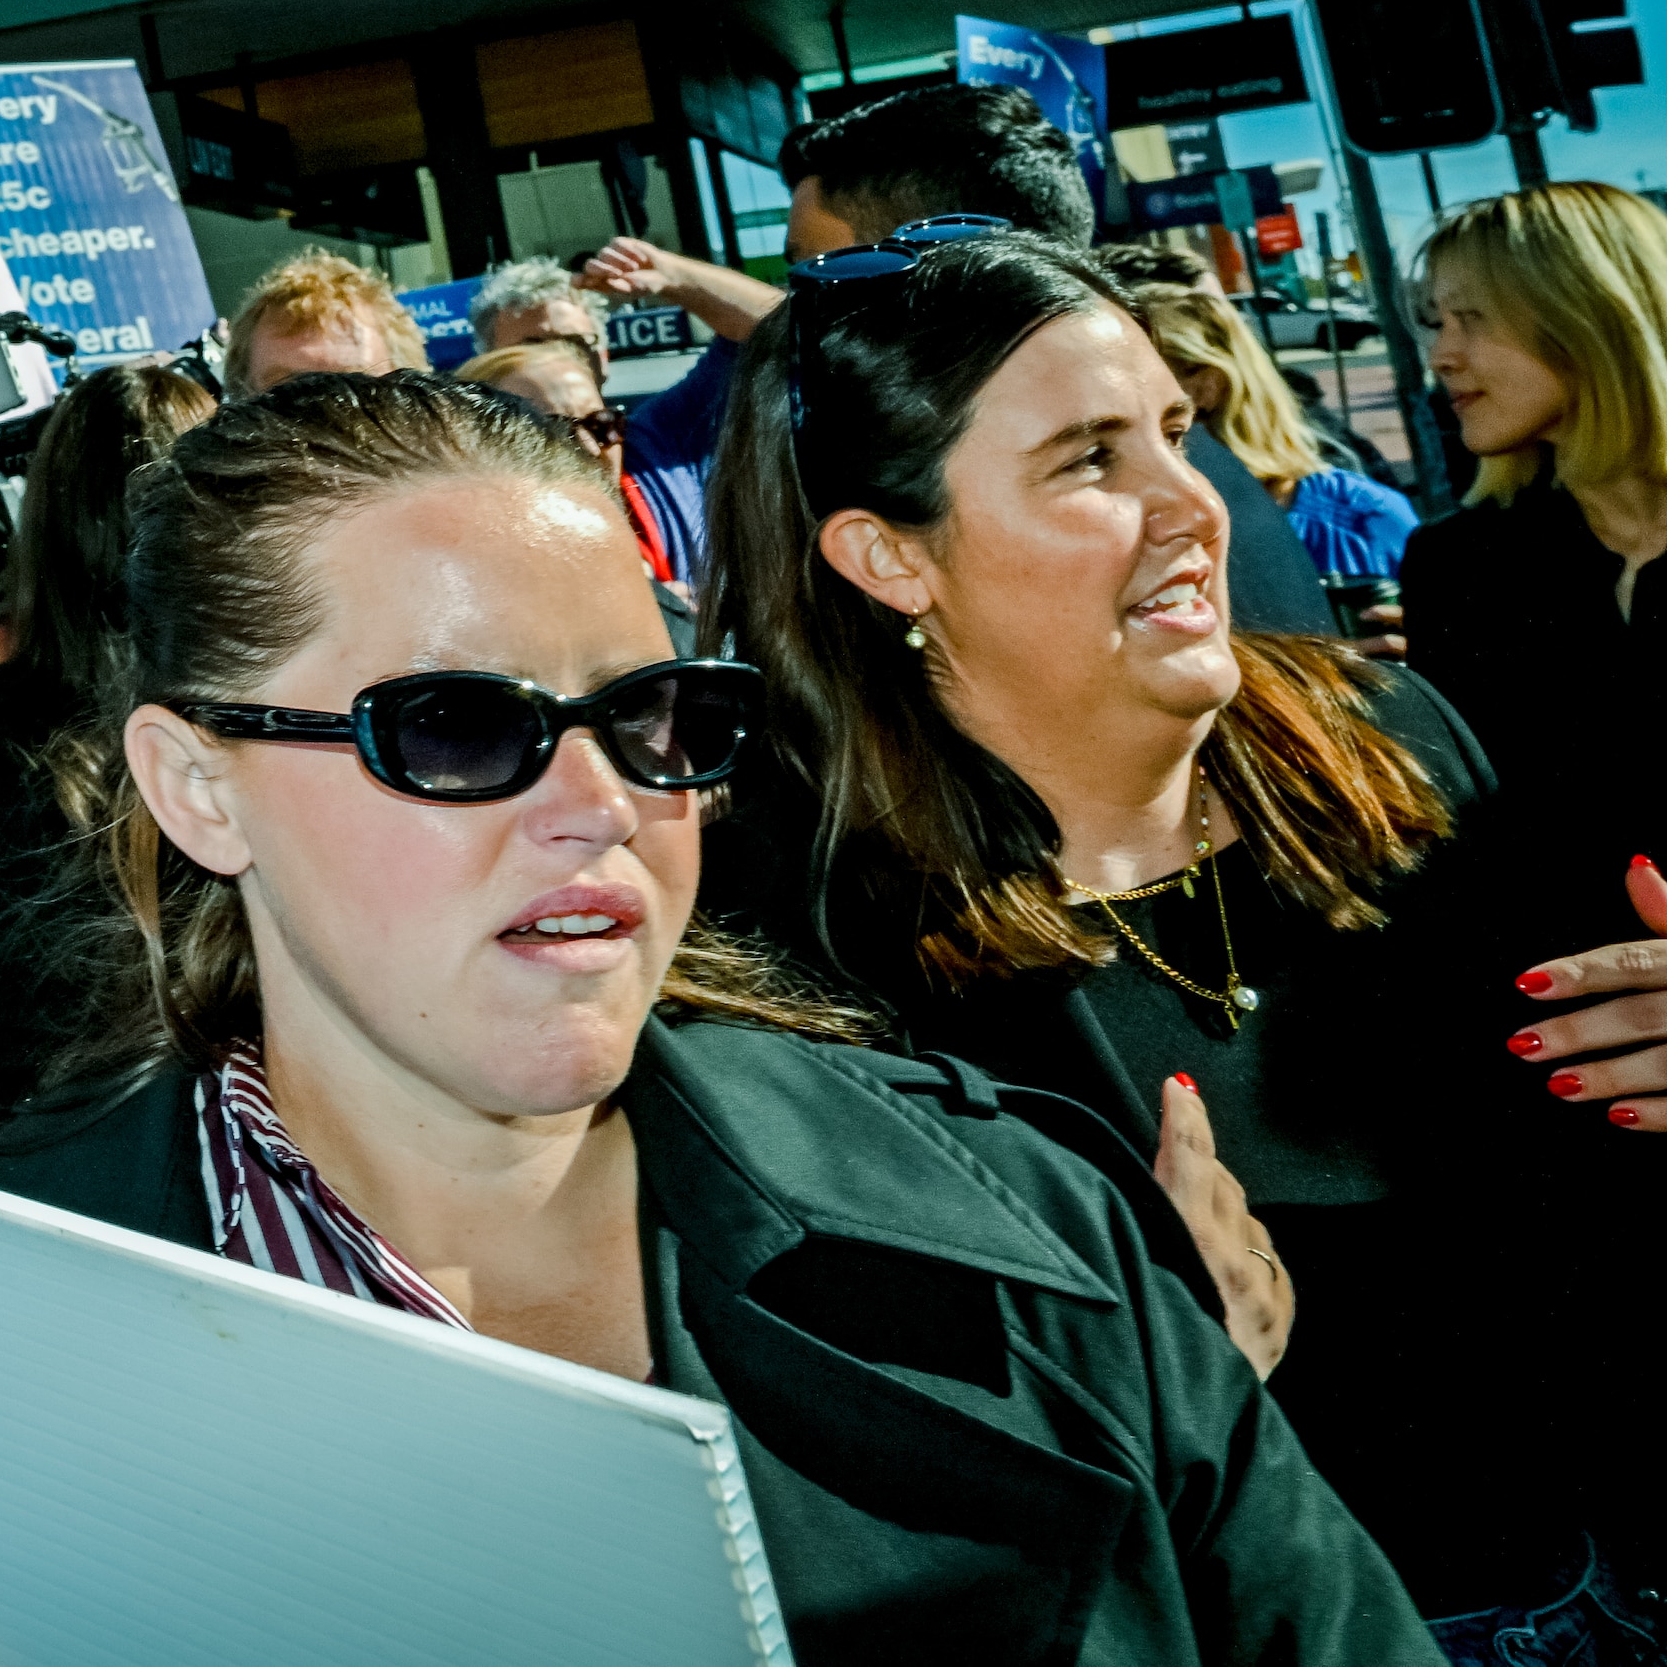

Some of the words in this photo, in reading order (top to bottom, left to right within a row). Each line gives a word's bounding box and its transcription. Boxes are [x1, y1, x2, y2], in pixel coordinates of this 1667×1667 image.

[969, 35, 1044, 79] Every
[76, 316, 154, 354] eral
[606, 315, 681, 349] ICE
